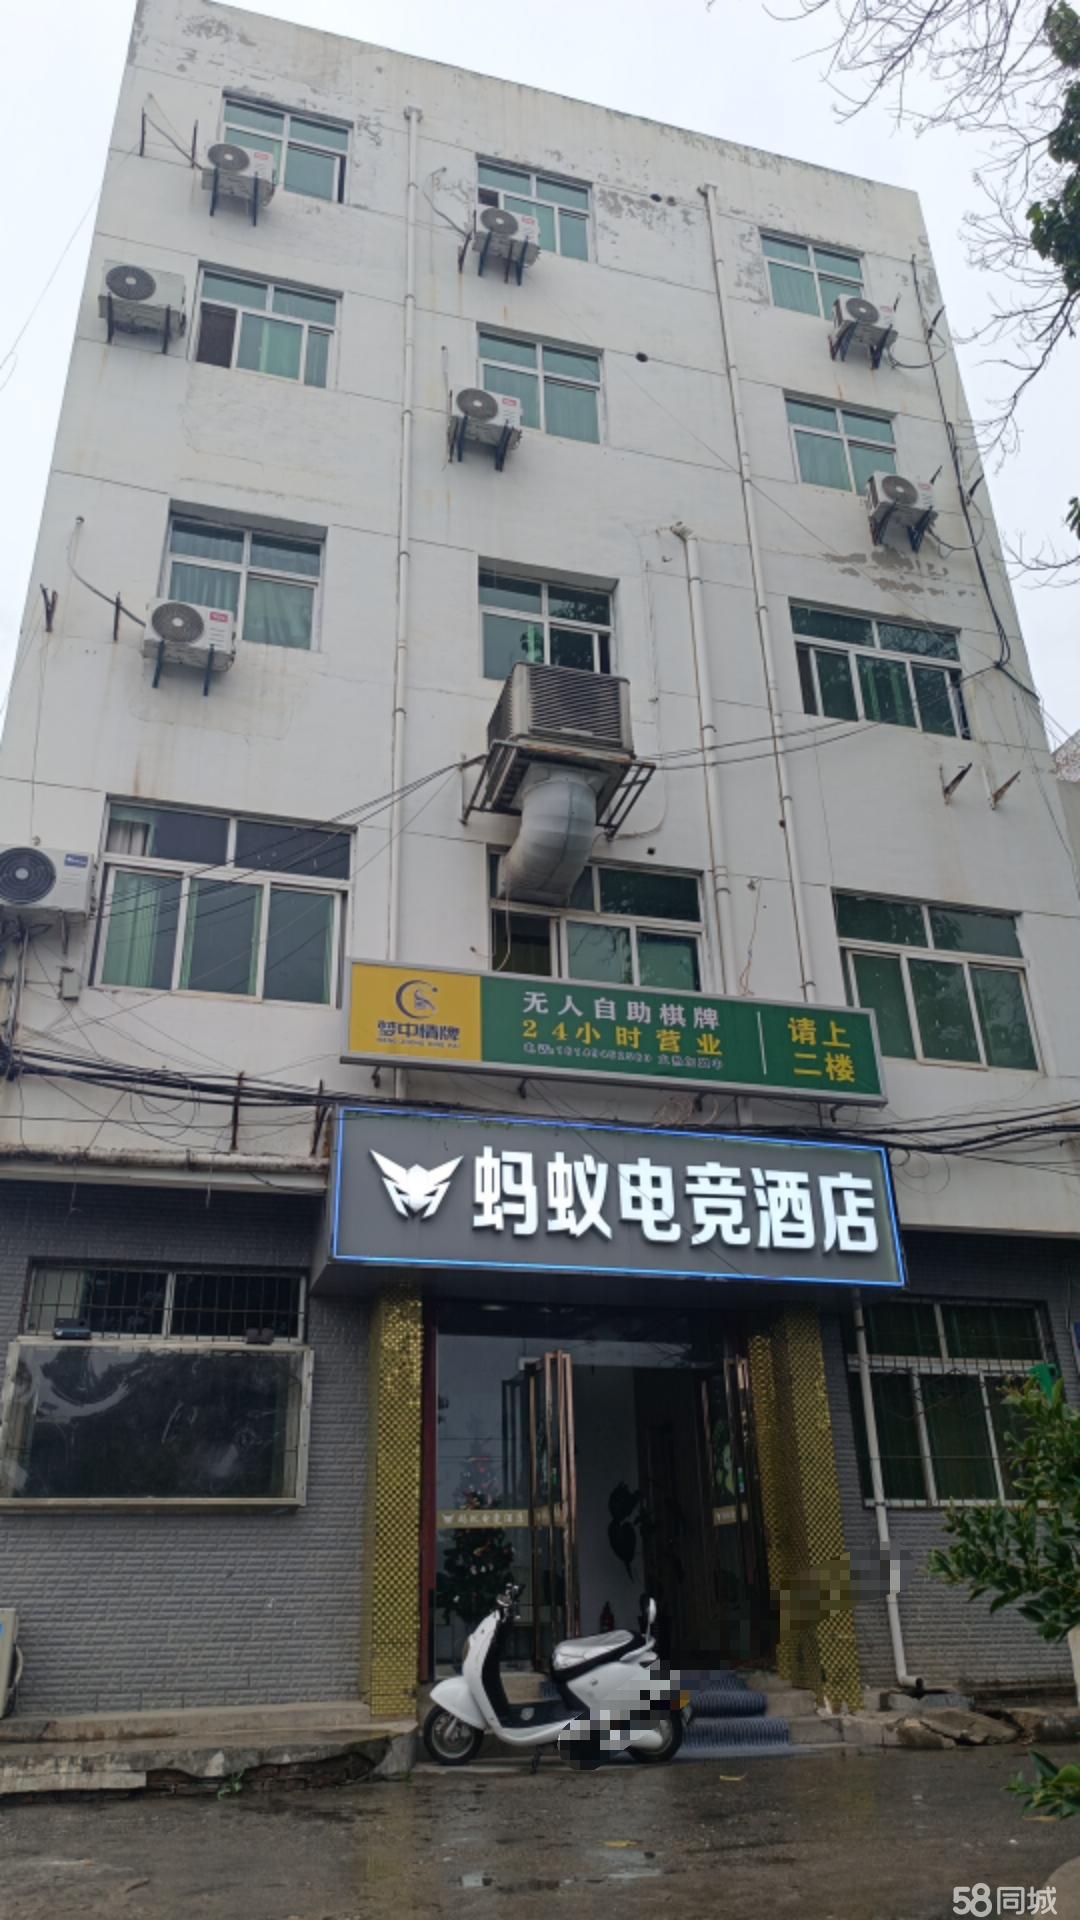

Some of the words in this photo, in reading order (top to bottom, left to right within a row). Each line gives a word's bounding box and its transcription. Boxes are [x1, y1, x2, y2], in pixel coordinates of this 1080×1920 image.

[523, 991, 720, 1030] 无人自助棋牌
[522, 1018, 722, 1056] 24小时营业
[787, 1017, 851, 1046] 请上
[793, 1051, 855, 1082] 二楼
[474, 1146, 879, 1254] 蚂蚁电竞酒店
